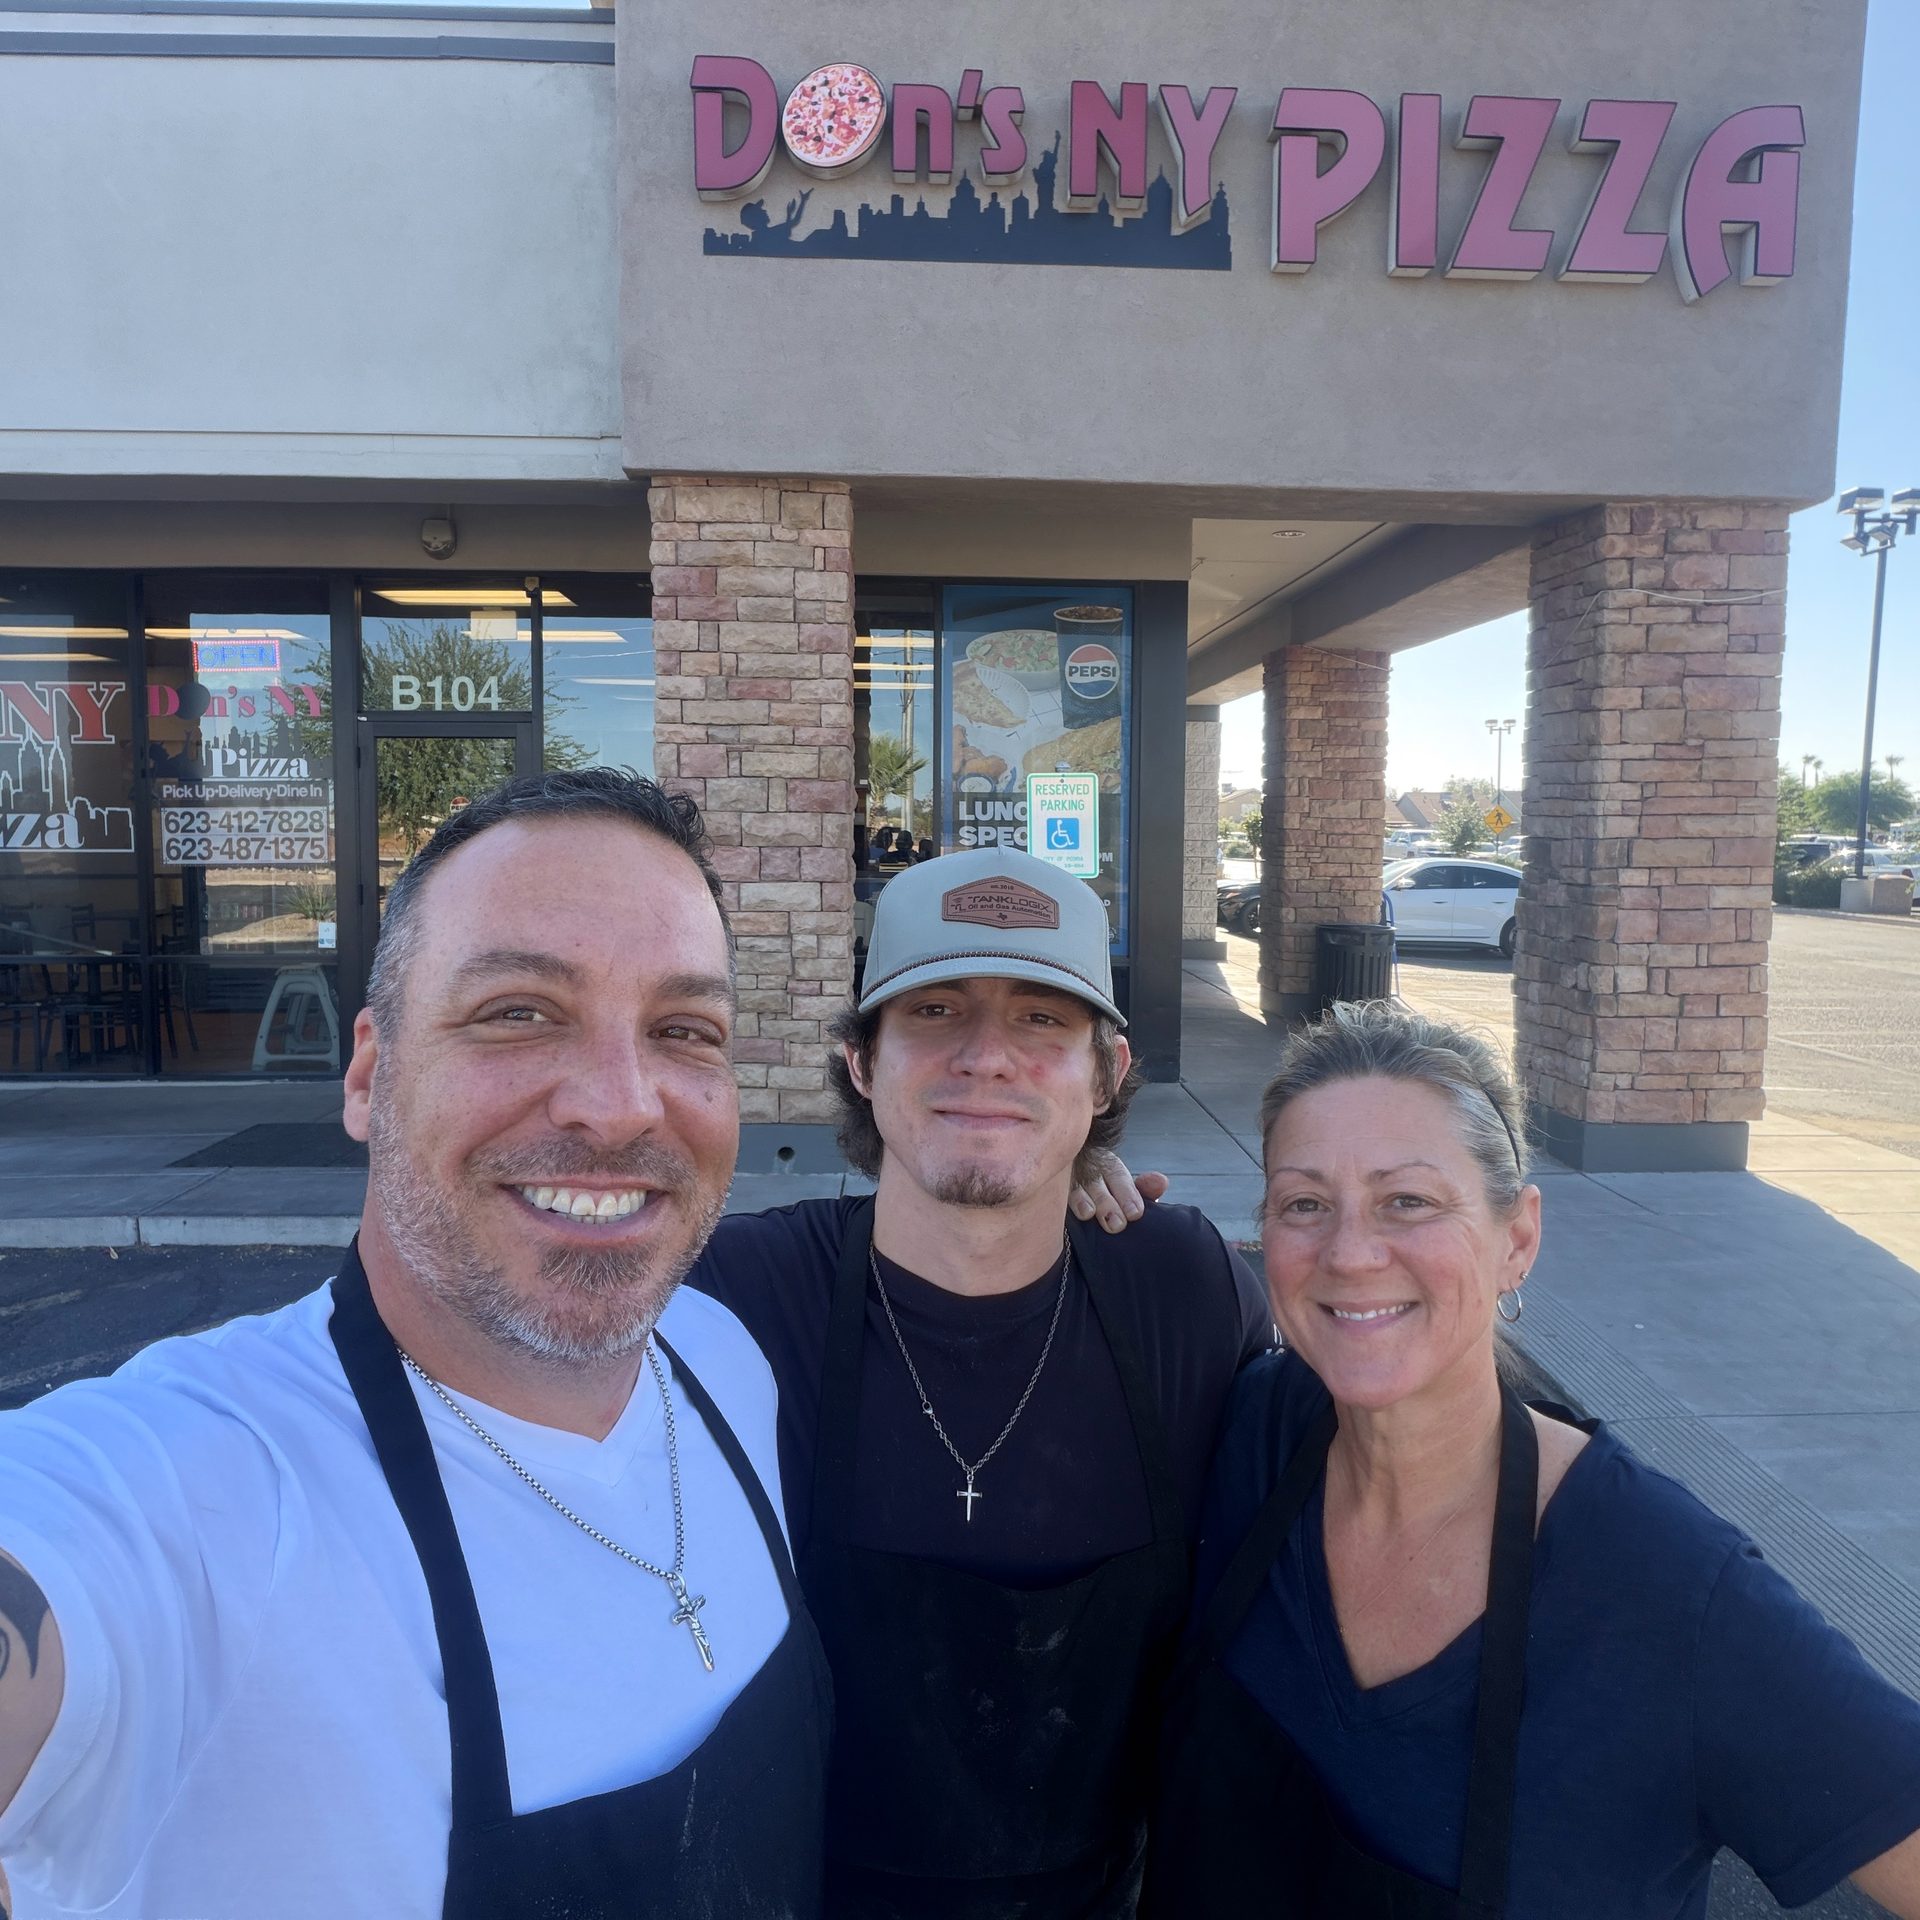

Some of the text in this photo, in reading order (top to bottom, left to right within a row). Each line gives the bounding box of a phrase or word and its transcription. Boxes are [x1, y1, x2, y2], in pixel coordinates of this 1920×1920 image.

[1068, 80, 1238, 225] NY
[1271, 87, 1806, 300] PIZZA
[199, 645, 276, 669] OPEN
[1068, 665, 1117, 678] PEPSI
[264, 685, 328, 717] NY
[392, 674, 503, 712] B104
[0, 681, 126, 744] NY
[209, 748, 310, 778] Pizza
[162, 784, 193, 798] Pick
[310, 784, 323, 797] In
[1035, 784, 1090, 795] RESERVED
[1040, 799, 1086, 811] PARKING
[0, 813, 85, 849] za
[164, 810, 325, 834] 623-412-7828
[165, 837, 326, 861] 623-487-1375
[968, 895, 1052, 913] TANKLOGIX
[1012, 905, 1051, 919] Automation
